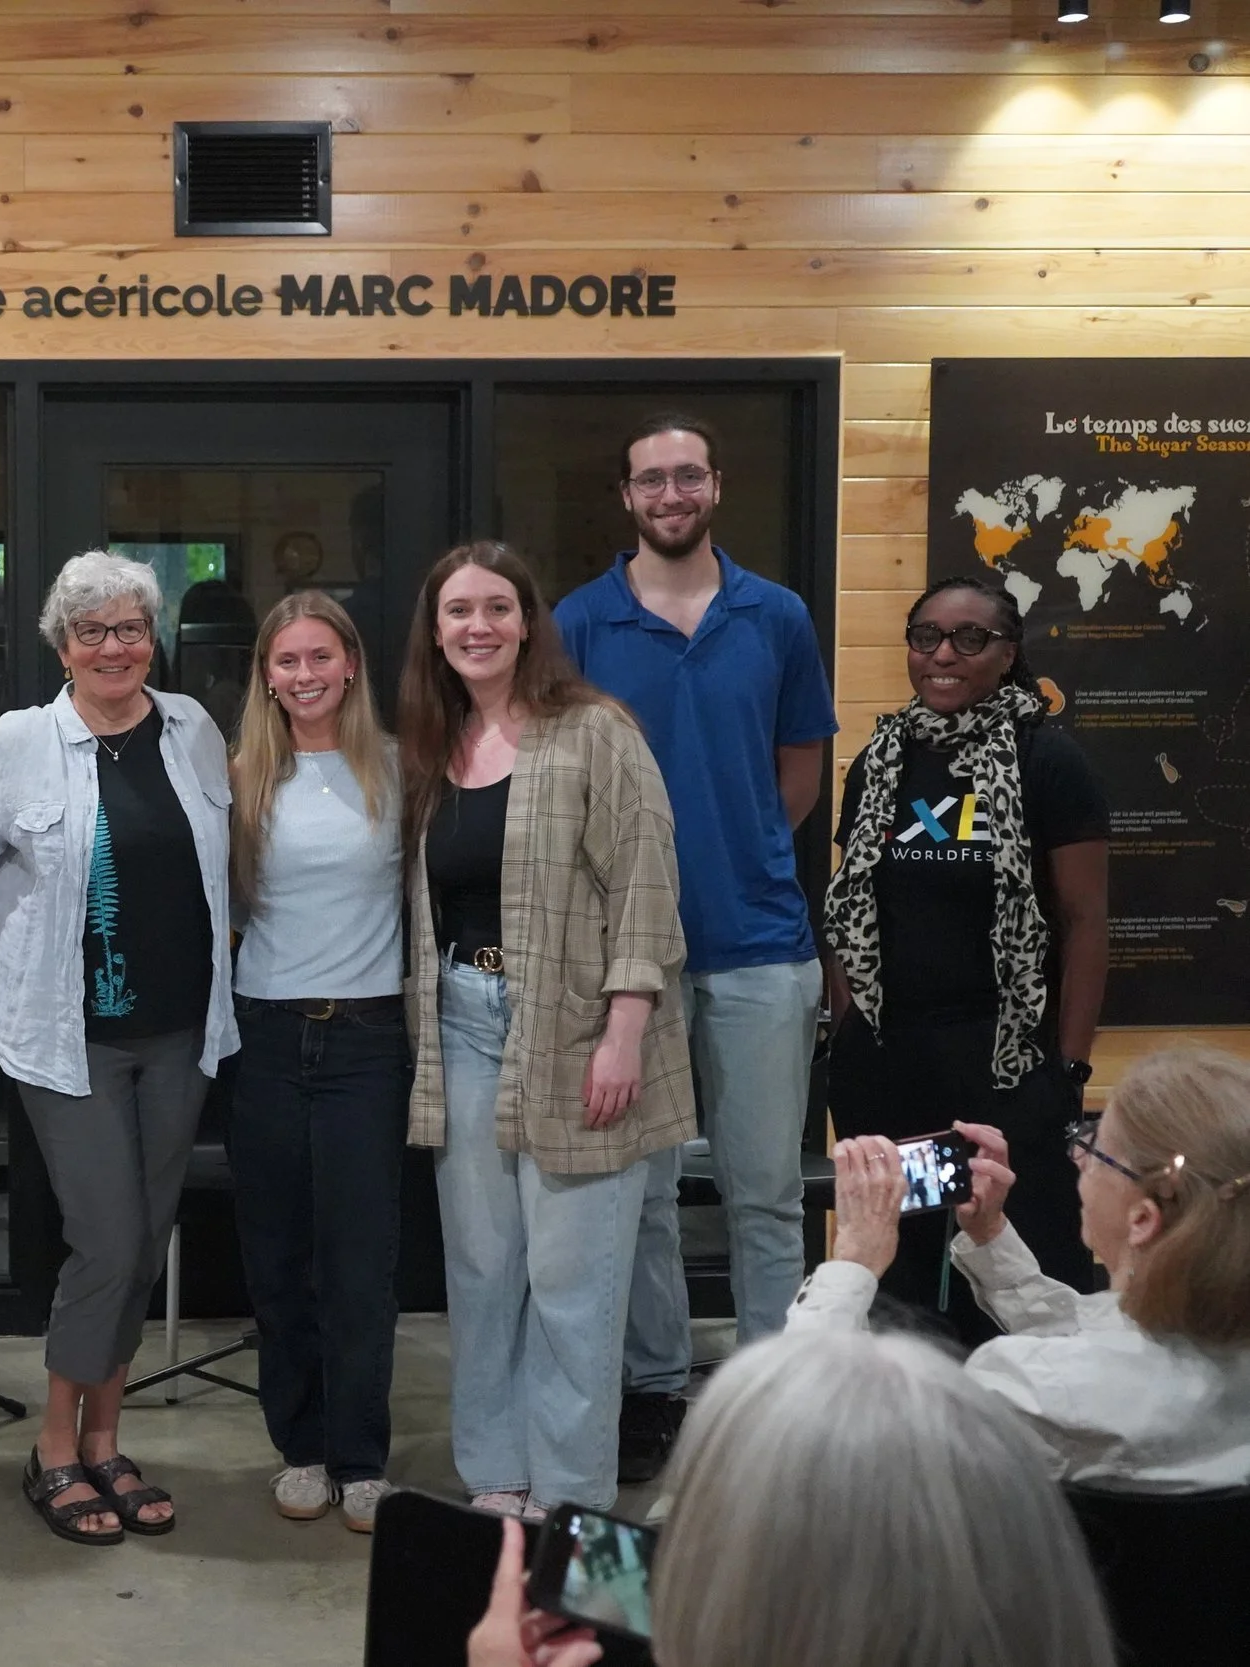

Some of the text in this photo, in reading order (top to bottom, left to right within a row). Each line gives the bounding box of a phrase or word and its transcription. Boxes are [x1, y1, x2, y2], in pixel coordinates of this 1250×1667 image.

[23, 273, 263, 319] acéricole
[280, 273, 434, 317] MARC
[449, 273, 677, 318] MADORE
[1045, 412, 1077, 434] Le
[1082, 414, 1158, 440] temps
[1163, 412, 1202, 434] des
[1095, 434, 1132, 452] The
[1136, 434, 1192, 458] Sugar
[891, 847, 994, 862] WORLDFES
